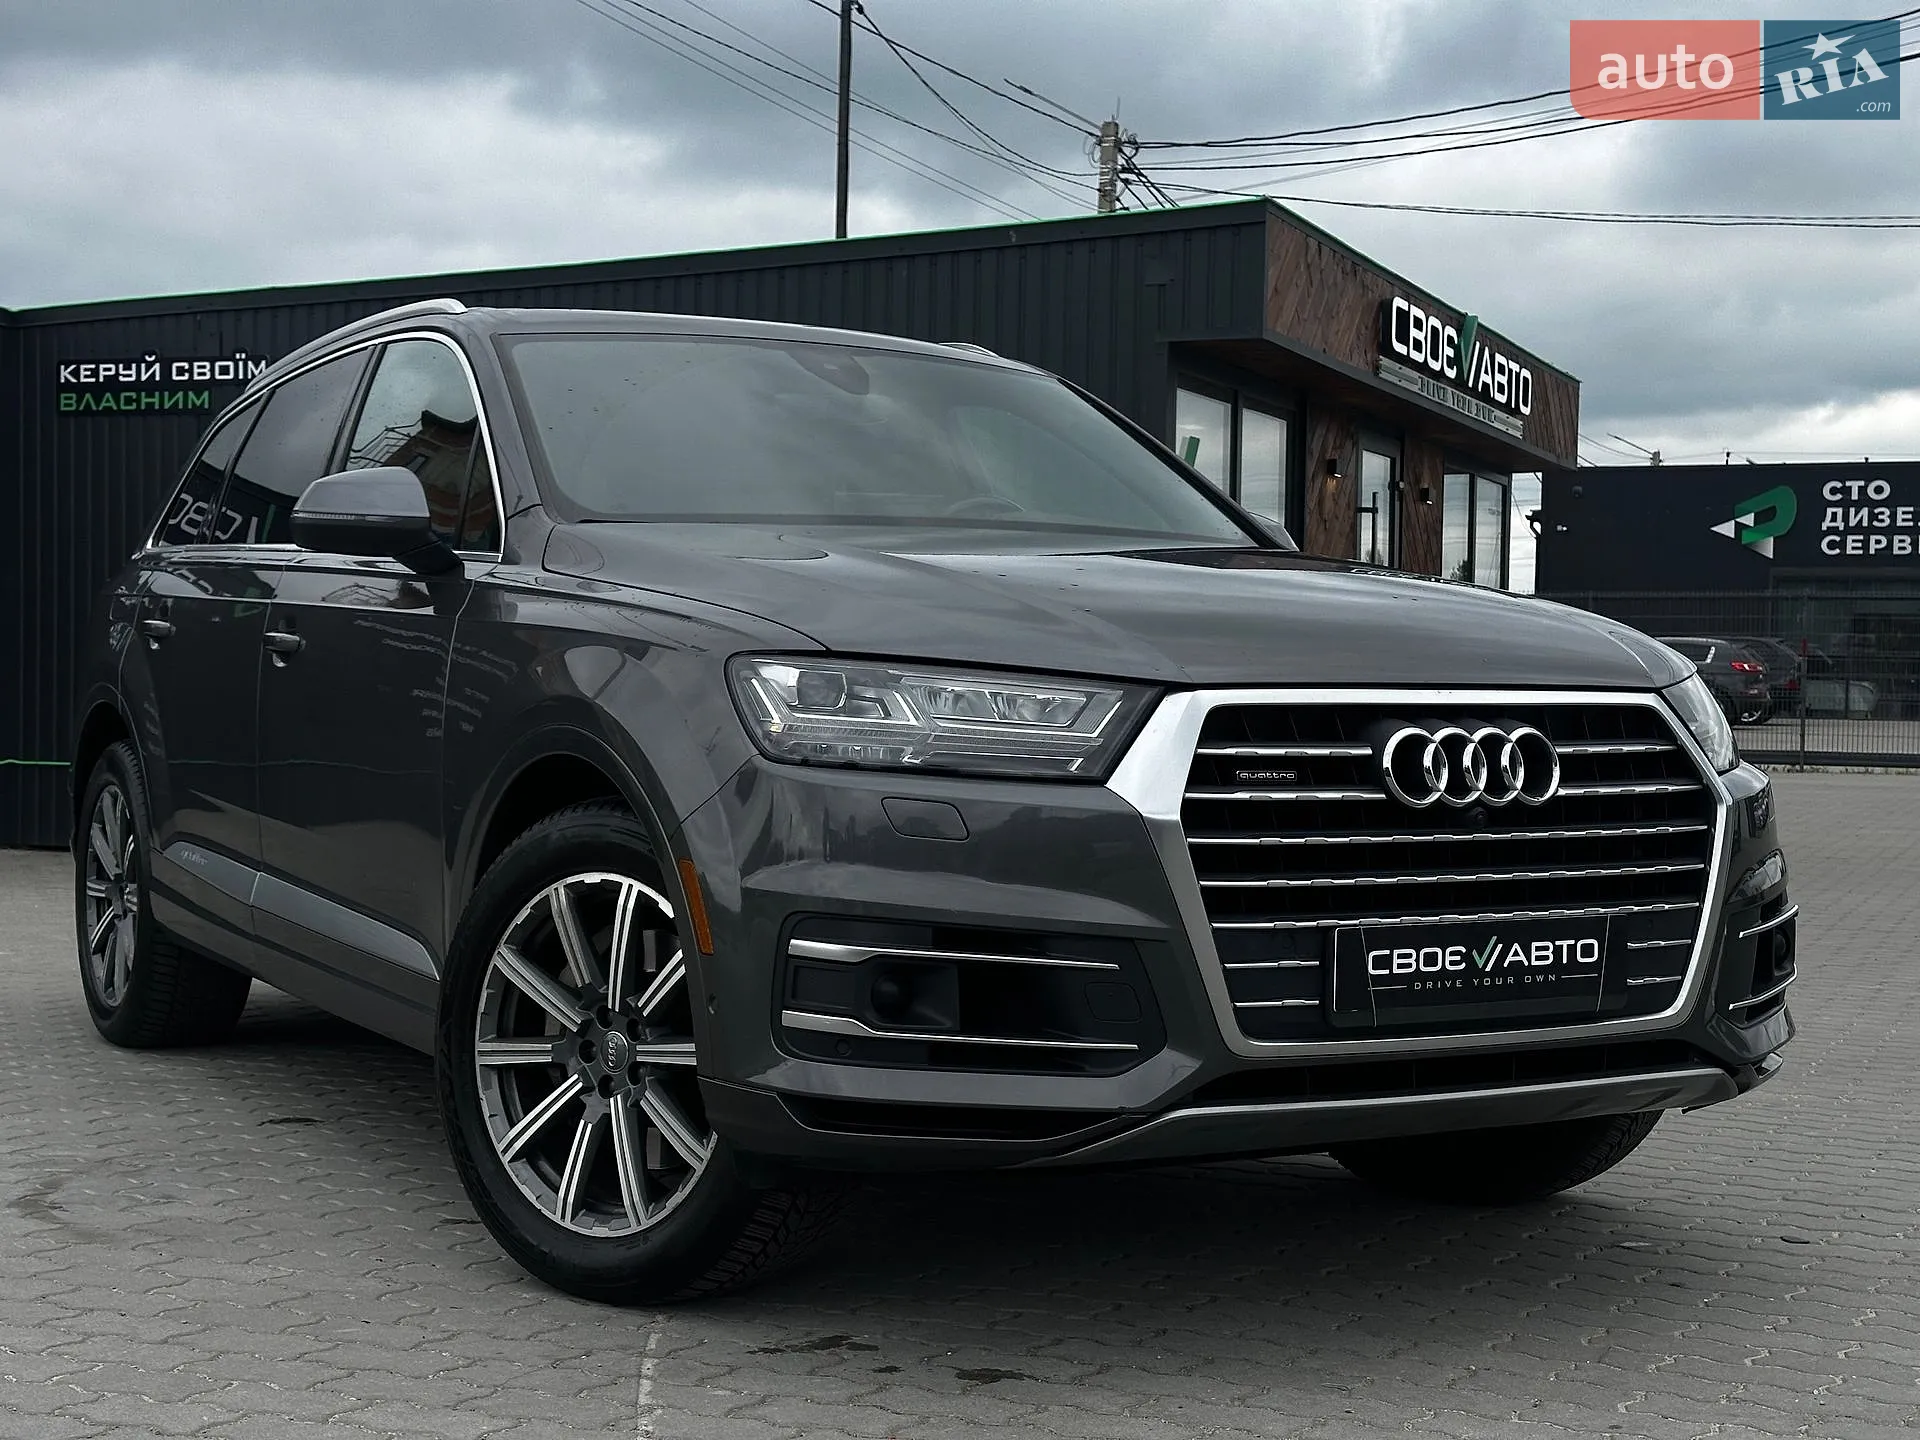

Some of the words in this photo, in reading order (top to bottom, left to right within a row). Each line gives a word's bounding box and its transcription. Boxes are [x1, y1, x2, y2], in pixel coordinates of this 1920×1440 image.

[59, 354, 161, 383] КЕРУЙ
[171, 353, 267, 381] СВОЇМ
[1477, 346, 1533, 416] АВТО
[59, 389, 210, 411] ВЛАСНИМ
[1822, 479, 1891, 501] СТО
[1821, 506, 1920, 531] ДИЗЕ
[1820, 534, 1920, 556] СЕРВ
[1239, 772, 1296, 780] quattro
[1503, 938, 1599, 968] АВТО
[1414, 979, 1463, 990] DRIVE
[1472, 975, 1514, 986] YOUR
[1524, 974, 1557, 984] OWN
